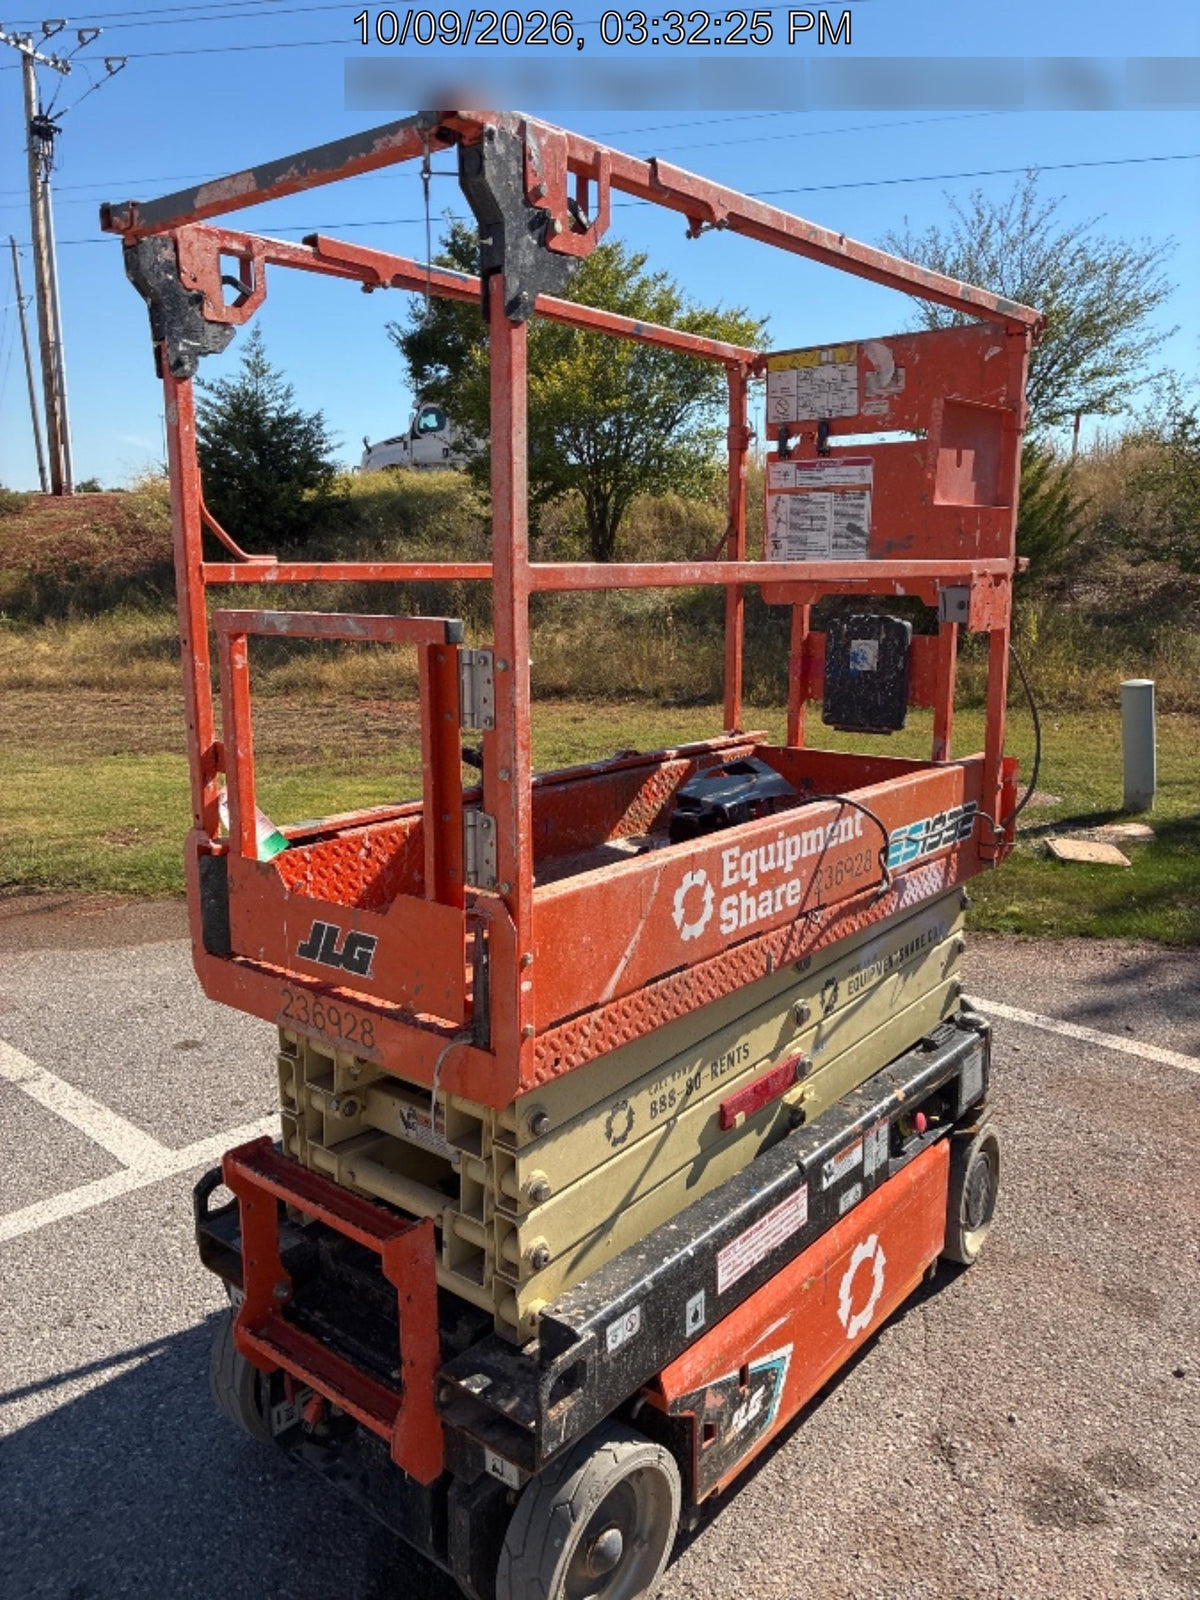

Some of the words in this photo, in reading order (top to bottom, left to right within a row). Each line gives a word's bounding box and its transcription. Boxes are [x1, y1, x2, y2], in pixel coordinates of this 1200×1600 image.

[720, 810, 865, 888] Equipment
[719, 877, 802, 935] Share
[296, 919, 380, 979] JLG
[280, 990, 375, 1049] 236928
